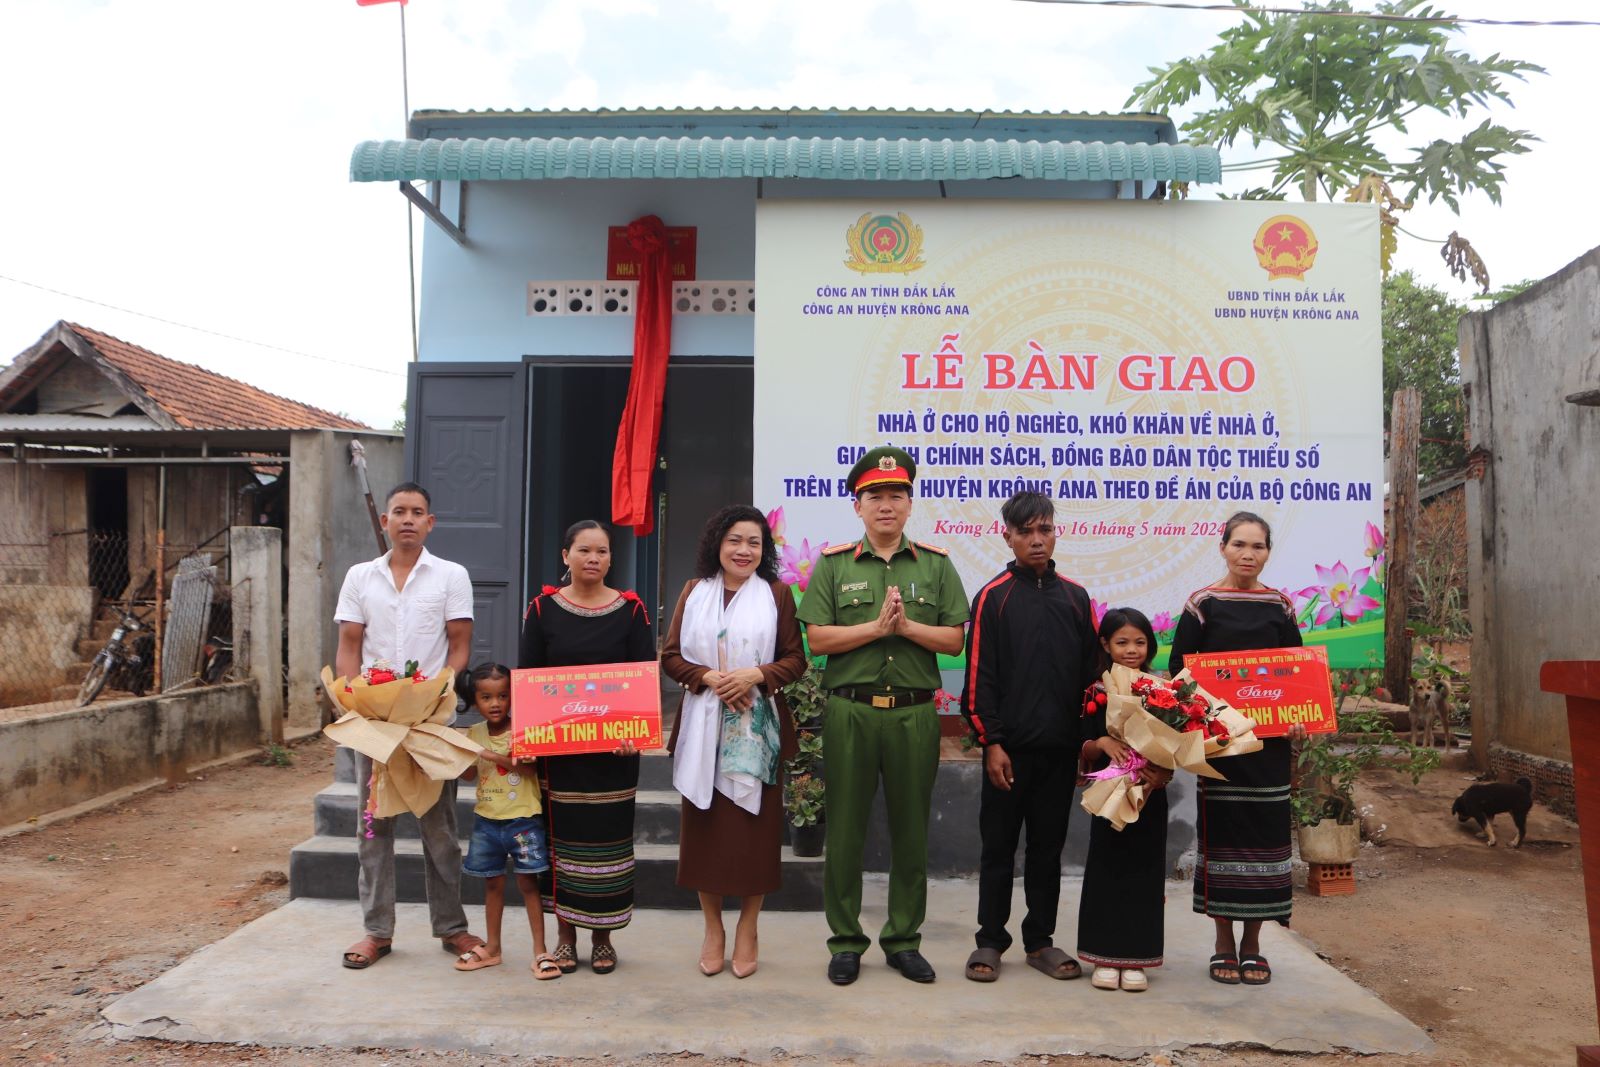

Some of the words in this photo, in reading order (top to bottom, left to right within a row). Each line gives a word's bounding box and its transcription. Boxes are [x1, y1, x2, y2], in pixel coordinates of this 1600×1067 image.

[816, 284, 847, 297] CÔNG
[851, 288, 867, 297] AN
[871, 284, 899, 297] TỈNH
[903, 282, 928, 297] ĐẮK
[932, 282, 956, 297] LẮK
[1227, 291, 1259, 301] UBND
[1263, 289, 1290, 301] TỈNH
[1295, 287, 1318, 302] ĐẮK
[1323, 288, 1345, 303] LẮK
[802, 302, 833, 315] CÔNG
[837, 305, 853, 314] AN
[857, 302, 897, 317] HUYỆN
[901, 302, 941, 315] KRÔNG
[945, 305, 969, 315] ANA
[1214, 308, 1246, 318] UBND
[1250, 307, 1288, 322] HUYỆN
[1292, 307, 1331, 320] KRÔNG
[1335, 310, 1359, 320] ANA
[901, 333, 963, 390] LỄ
[983, 340, 1098, 391] BÀN
[1118, 354, 1256, 393] GIAO
[877, 409, 917, 433] NHÀ
[923, 408, 936, 433] Ở
[941, 414, 979, 433] CHO
[985, 411, 1010, 437] HỘ
[1016, 410, 1083, 437] NGHÈO,
[1090, 411, 1127, 434] KHÓ
[1133, 412, 1184, 435] KHĂN
[1190, 410, 1212, 435] VỀ
[1218, 412, 1256, 435] NHÀ
[1262, 411, 1280, 439] Ở,
[926, 443, 984, 466] CHÍNH
[990, 443, 1046, 468] SÁCH,
[1052, 441, 1103, 466] ĐỒNG
[1110, 444, 1147, 466] BÀO
[1153, 444, 1191, 467] DÂN
[1197, 445, 1231, 471] TỘC
[1237, 441, 1290, 468] THIỂU
[1295, 443, 1320, 468] SỐ
[784, 475, 831, 497] TRÊN
[920, 476, 985, 502] HUYỆN
[1058, 480, 1097, 499] ANA
[1103, 480, 1150, 499] THEO
[1155, 474, 1178, 499] ĐỀ
[1185, 477, 1211, 500] ÁN
[1217, 475, 1253, 500] CỦA
[1260, 478, 1284, 504] BỘ
[1290, 478, 1340, 500] CÔNG
[1346, 482, 1371, 500] AN
[934, 520, 983, 537] Krông
[1071, 522, 1088, 535] 16
[1092, 521, 1136, 538] tháng
[1140, 521, 1149, 535] 5
[1153, 523, 1186, 536] năm
[1191, 522, 1227, 536] 2024
[1277, 699, 1324, 724] NGHĨA
[524, 720, 556, 745] NHÀ
[560, 719, 597, 743] TÌNH
[602, 715, 650, 740] NGHĨA
